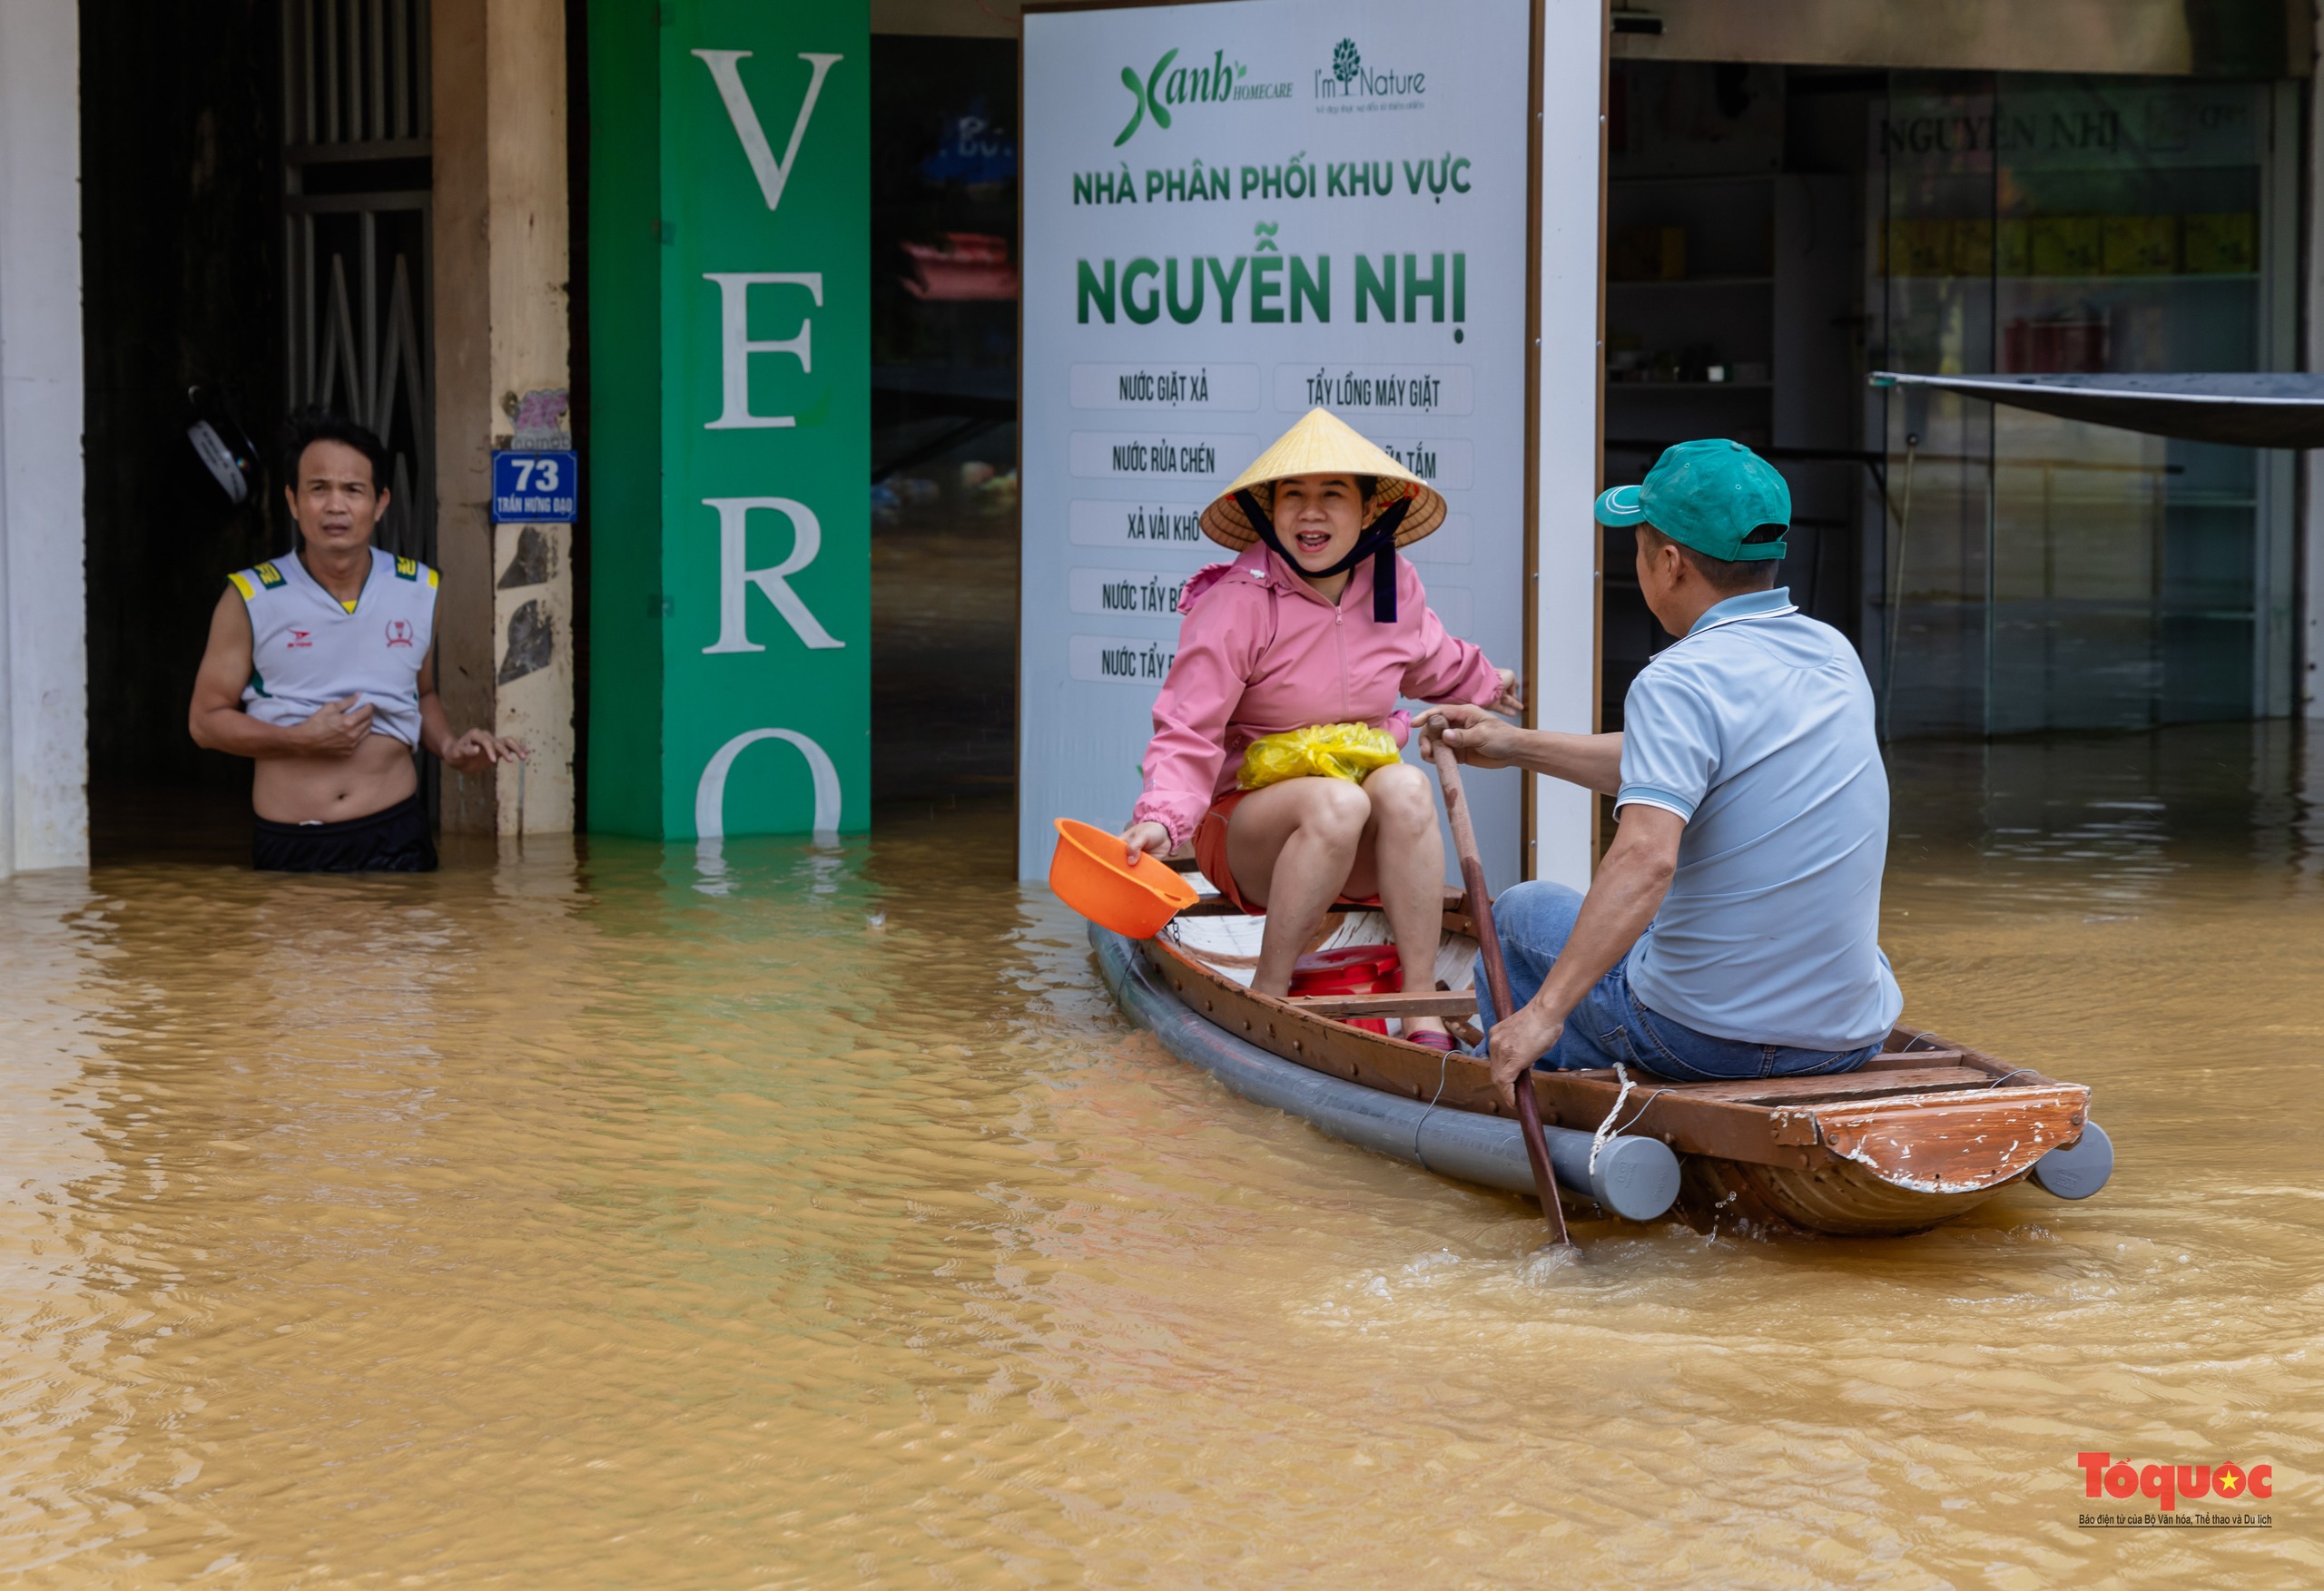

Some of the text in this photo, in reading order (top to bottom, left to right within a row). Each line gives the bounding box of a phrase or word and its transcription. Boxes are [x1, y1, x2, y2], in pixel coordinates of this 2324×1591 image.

[1114, 47, 1233, 147] Xanh
[1233, 83, 1294, 100] HOMECARE
[1315, 65, 1425, 99] I'm Nature
[1073, 151, 1472, 205] NHÀ PHÂN PHỐI KHU VỰC
[1078, 221, 1465, 344] NGUYỄN NHỊ
[1119, 367, 1208, 407] NƯỚC GIẶT XẢ
[1306, 367, 1441, 412] TẨY LỒNG MÁY GIẶT
[1112, 437, 1215, 473] NƯỚC RỬA CHÉN
[1406, 441, 1436, 478] TẮM
[511, 459, 559, 491] 73
[524, 496, 551, 513] HƯNG
[553, 496, 573, 516] ĐẠO
[1128, 506, 1200, 541] XẢ VẢI KHÔ
[1102, 579, 1137, 611] NƯỚC
[1140, 575, 1166, 613] TẨY
[1102, 646, 1136, 677] NƯỚC
[1139, 642, 1165, 679] TẨY
